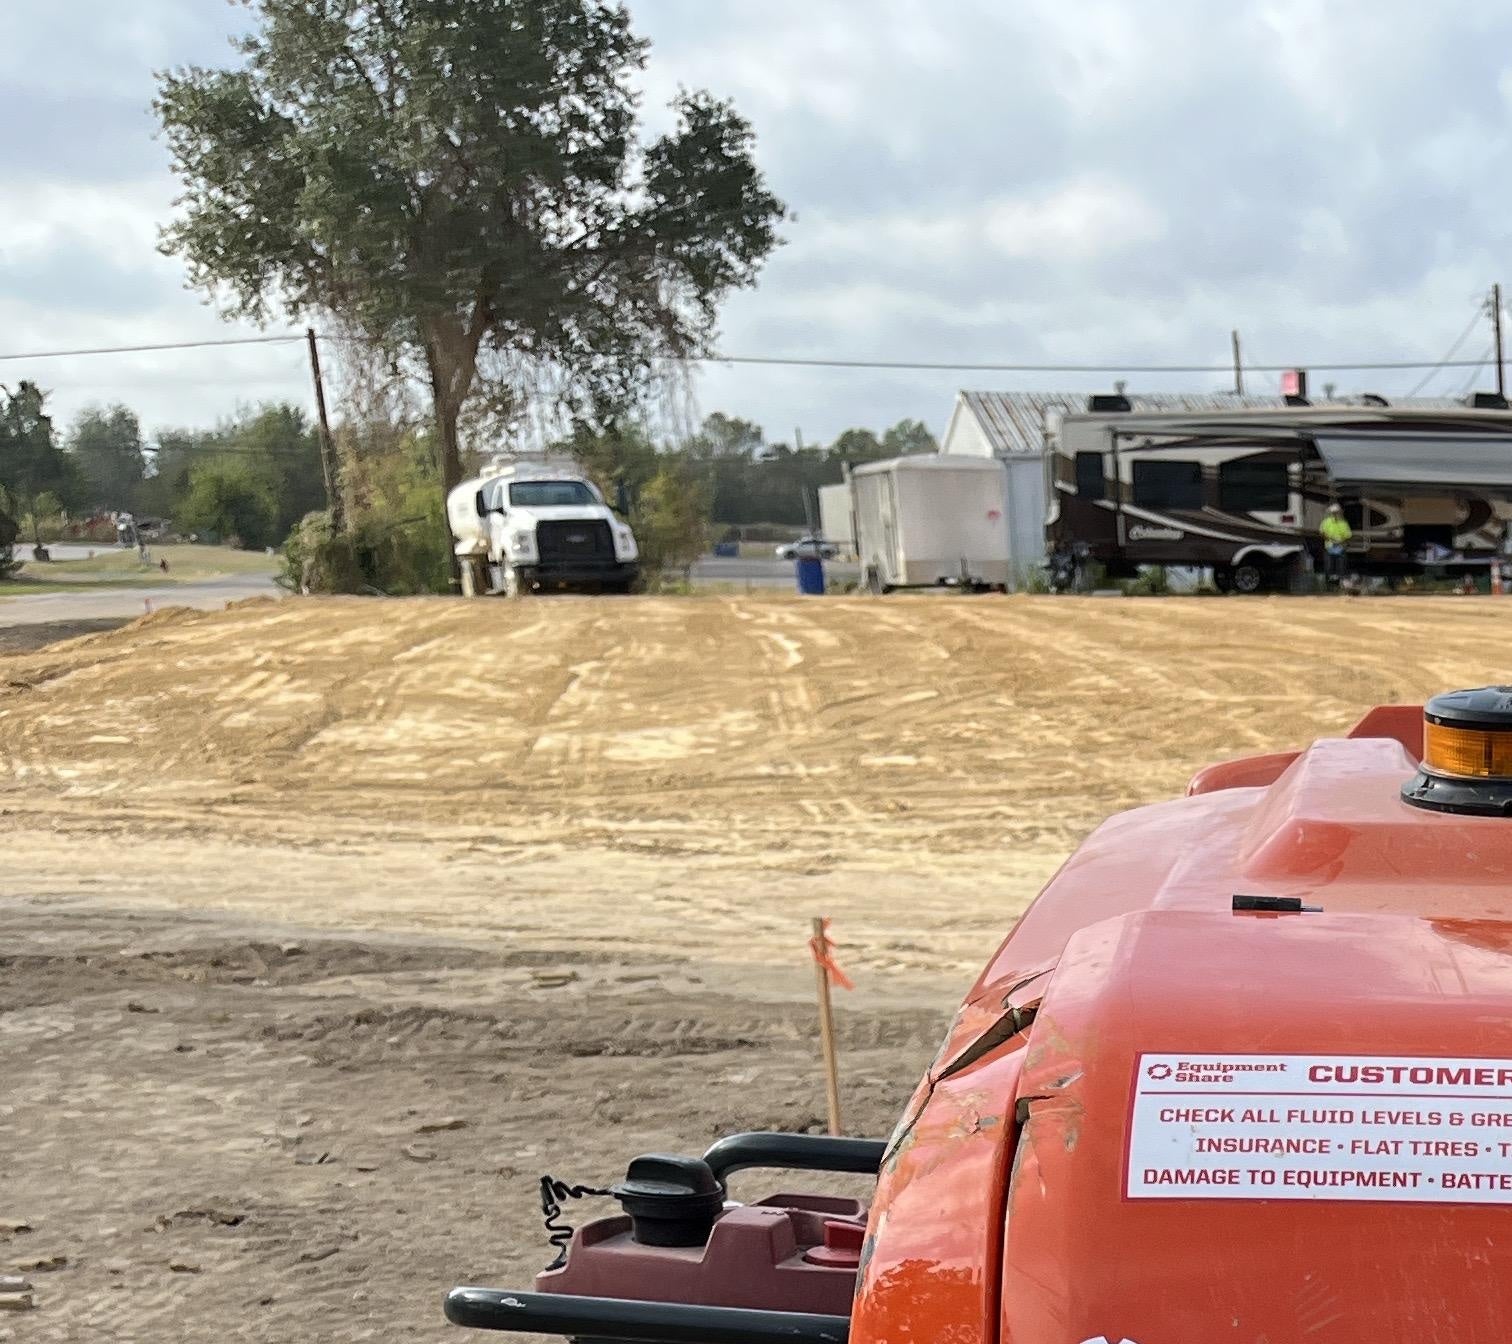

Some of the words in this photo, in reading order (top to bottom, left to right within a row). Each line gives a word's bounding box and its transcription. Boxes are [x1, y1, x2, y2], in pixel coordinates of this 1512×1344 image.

[1176, 1061, 1288, 1074] Equipment
[1174, 1072, 1235, 1083] Share
[1159, 1108, 1236, 1123] CHECK
[1241, 1109, 1282, 1123] ALL
[1286, 1110, 1355, 1124] FLUID
[1360, 1111, 1443, 1126] LEVELS
[1449, 1113, 1465, 1126] &
[1195, 1138, 1332, 1154] INSURANCE
[1350, 1140, 1404, 1155] FLAT
[1408, 1141, 1479, 1158] TIRES
[1142, 1169, 1241, 1186] DAMAGE
[1247, 1170, 1277, 1186] TO
[1283, 1170, 1423, 1189] EQUIPMENT
